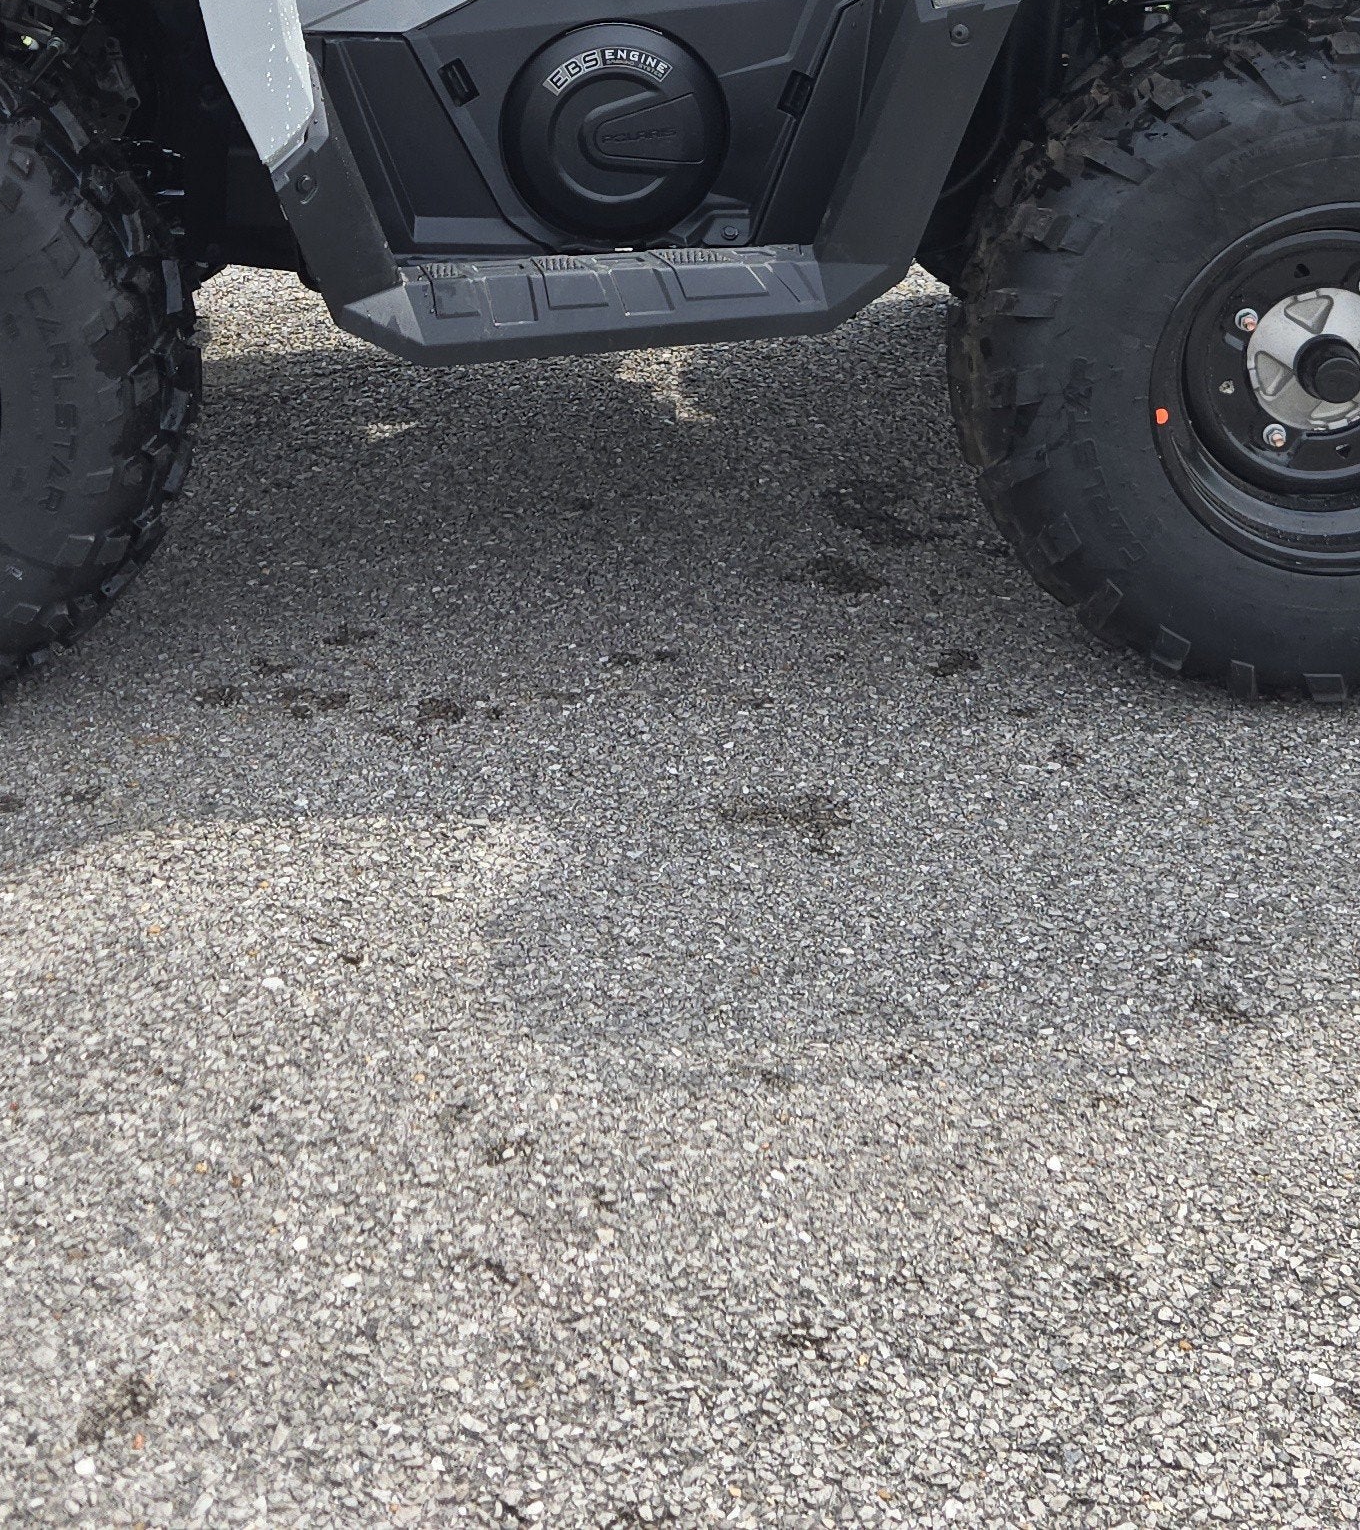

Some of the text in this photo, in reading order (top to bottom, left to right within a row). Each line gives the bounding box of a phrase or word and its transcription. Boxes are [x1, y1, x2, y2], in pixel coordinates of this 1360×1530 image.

[549, 49, 669, 90] EBS ENGINE
[601, 128, 678, 144] POLARIS
[24, 286, 79, 514] CARLSTAR
